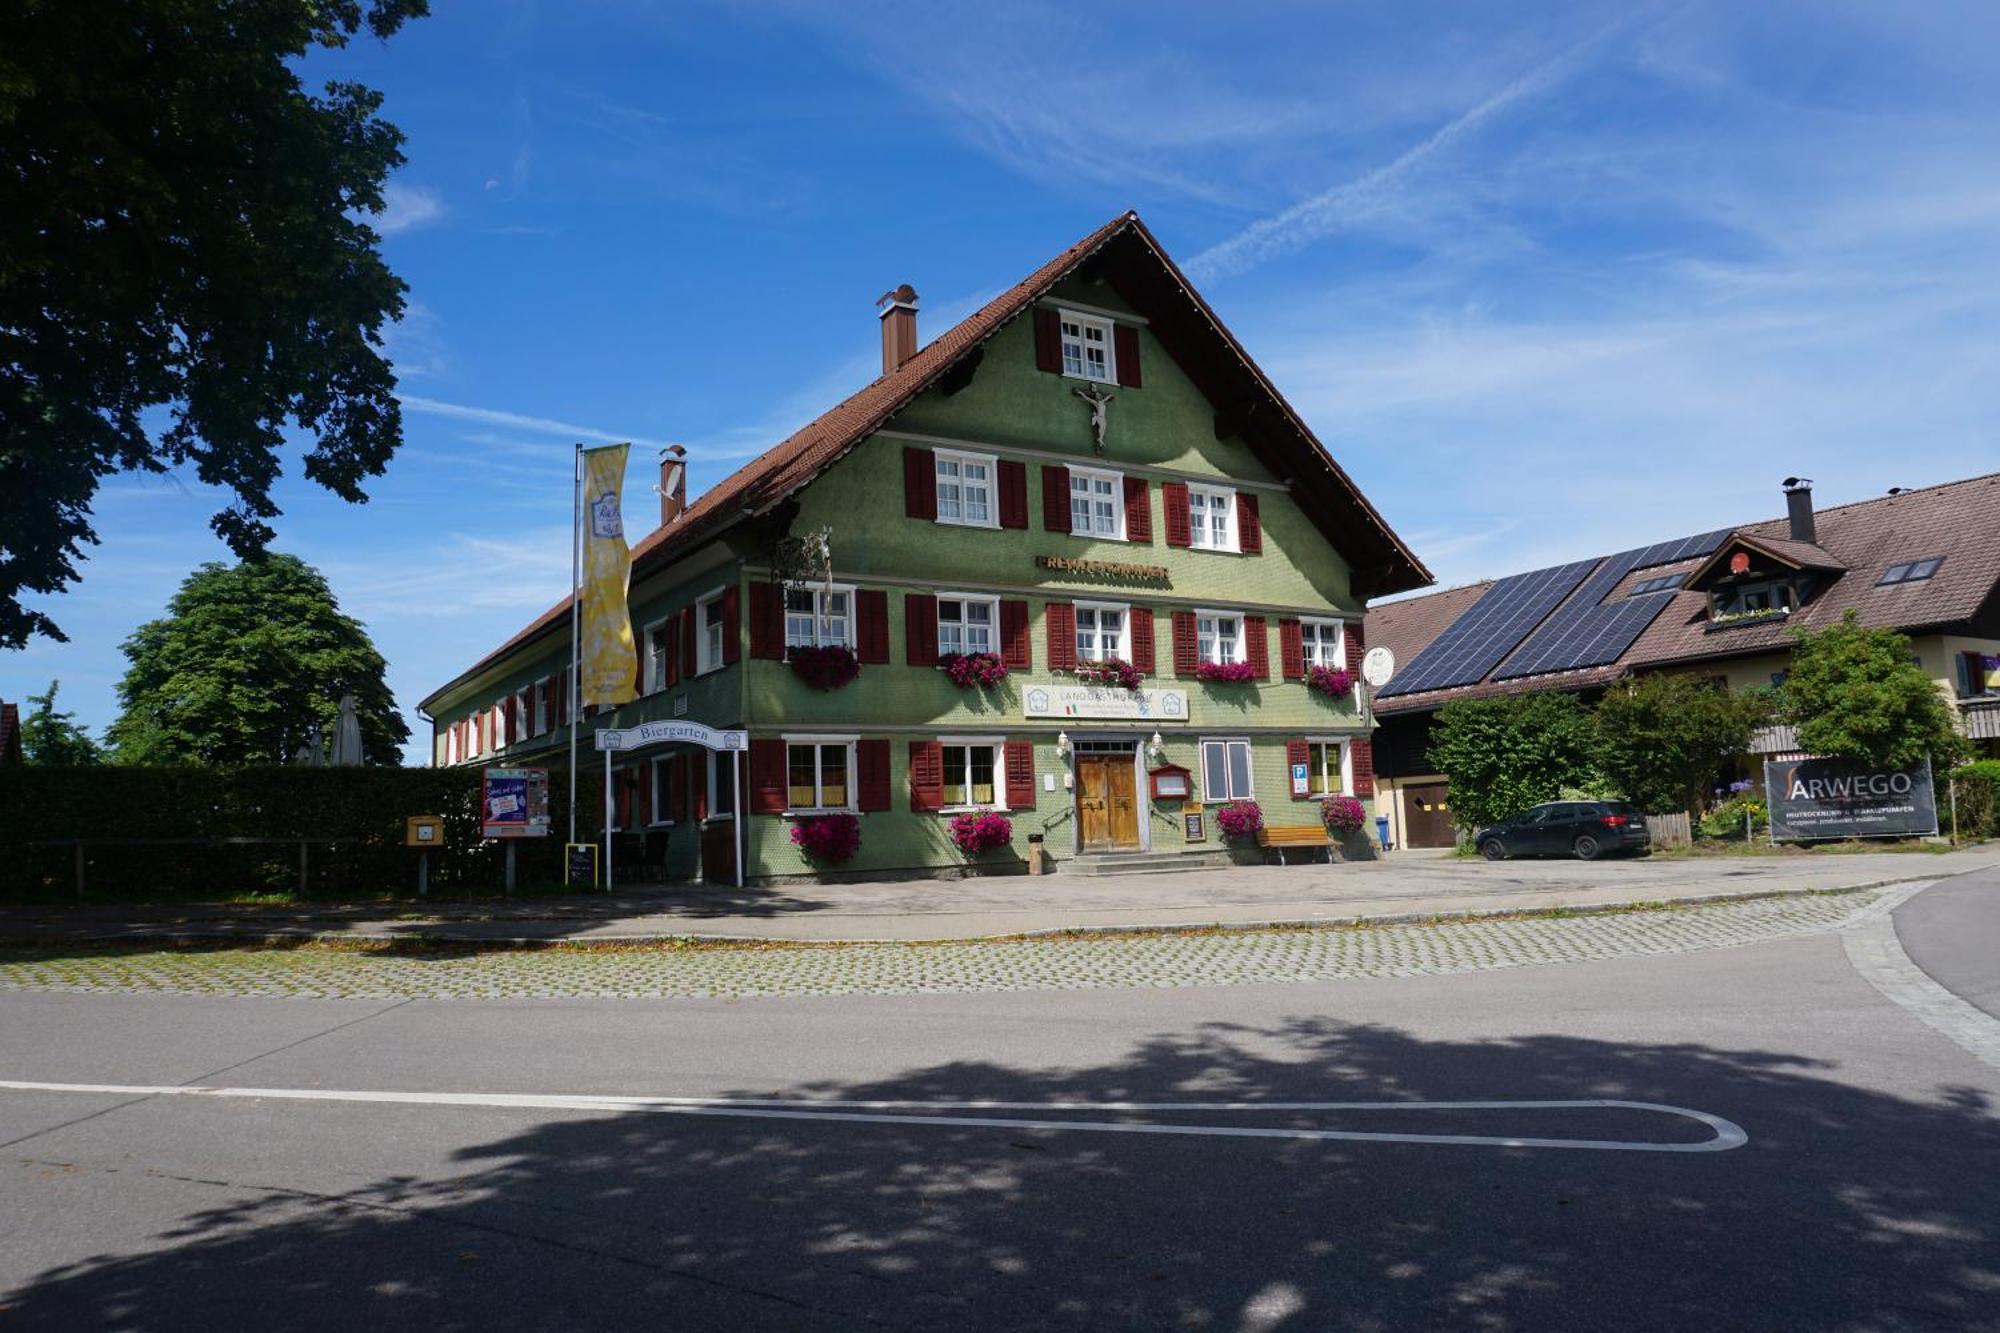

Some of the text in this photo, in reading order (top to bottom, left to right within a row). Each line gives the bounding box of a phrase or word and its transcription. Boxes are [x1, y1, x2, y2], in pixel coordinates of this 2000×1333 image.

[640, 725, 708, 740] Biergarten
[1296, 767, 1304, 778] P
[1791, 773, 1911, 800] ARWEGO
